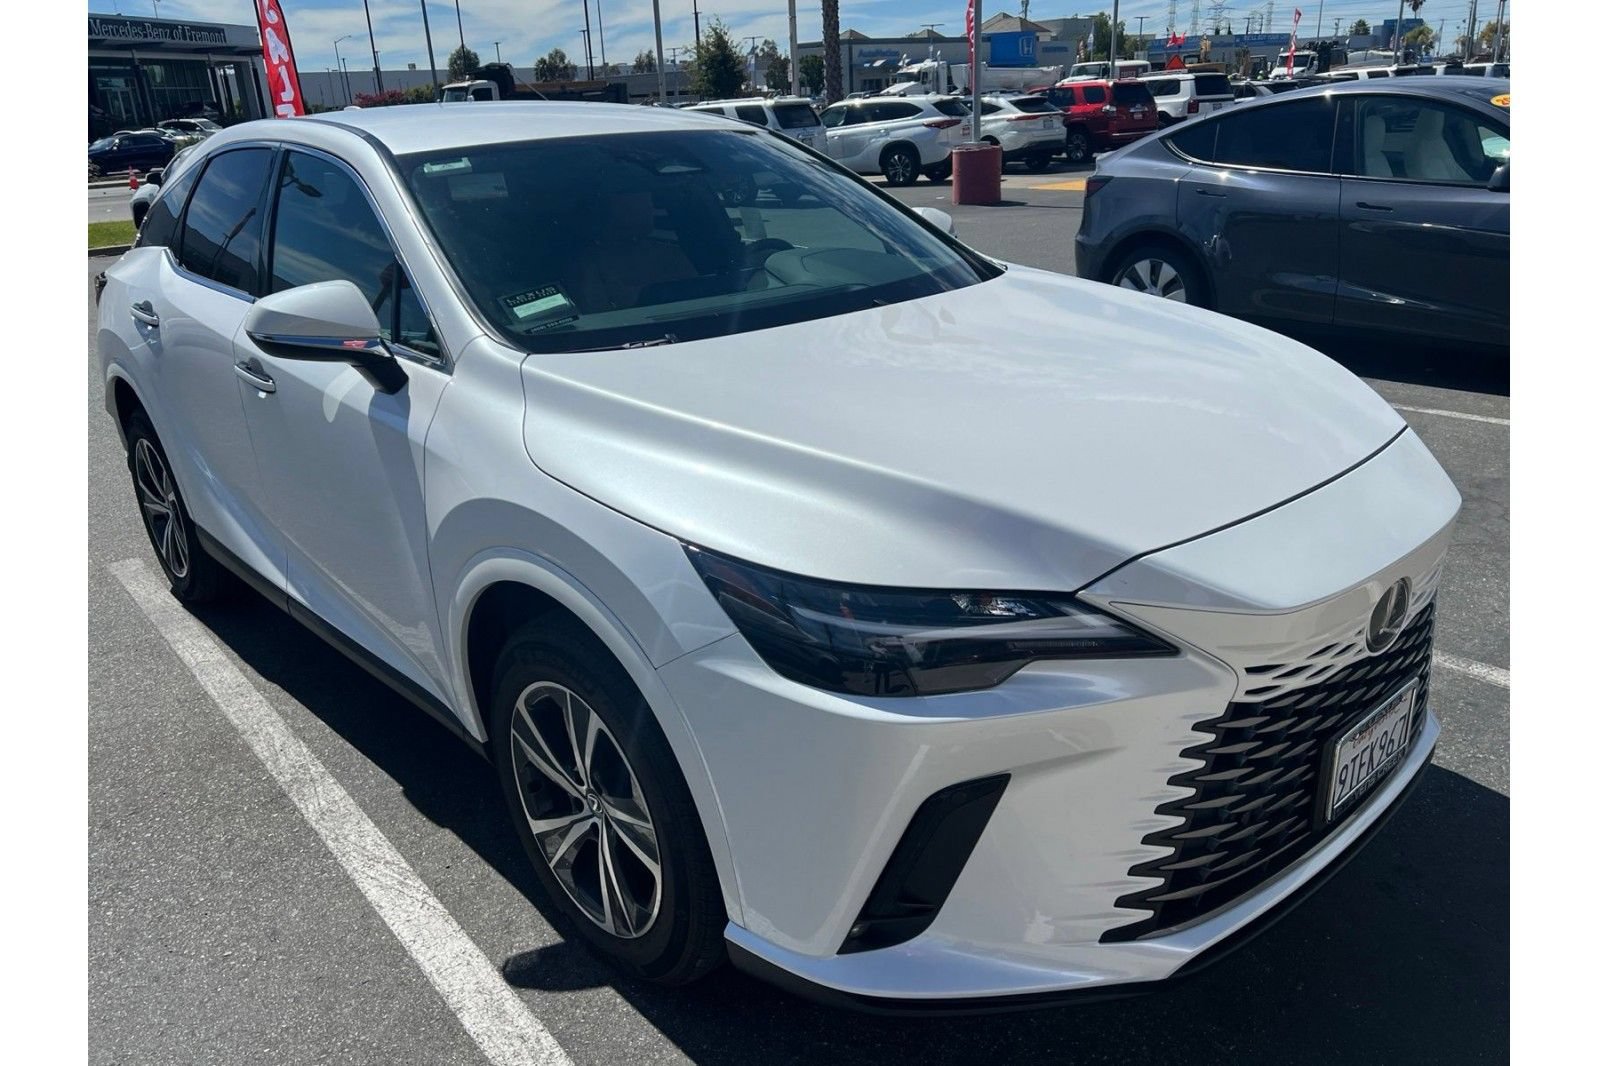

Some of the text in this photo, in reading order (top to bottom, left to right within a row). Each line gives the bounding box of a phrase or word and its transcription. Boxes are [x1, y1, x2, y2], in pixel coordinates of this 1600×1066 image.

[89, 20, 227, 43] Mercedes-Benz of Fremont
[1338, 713, 1407, 801] 9TFK967
